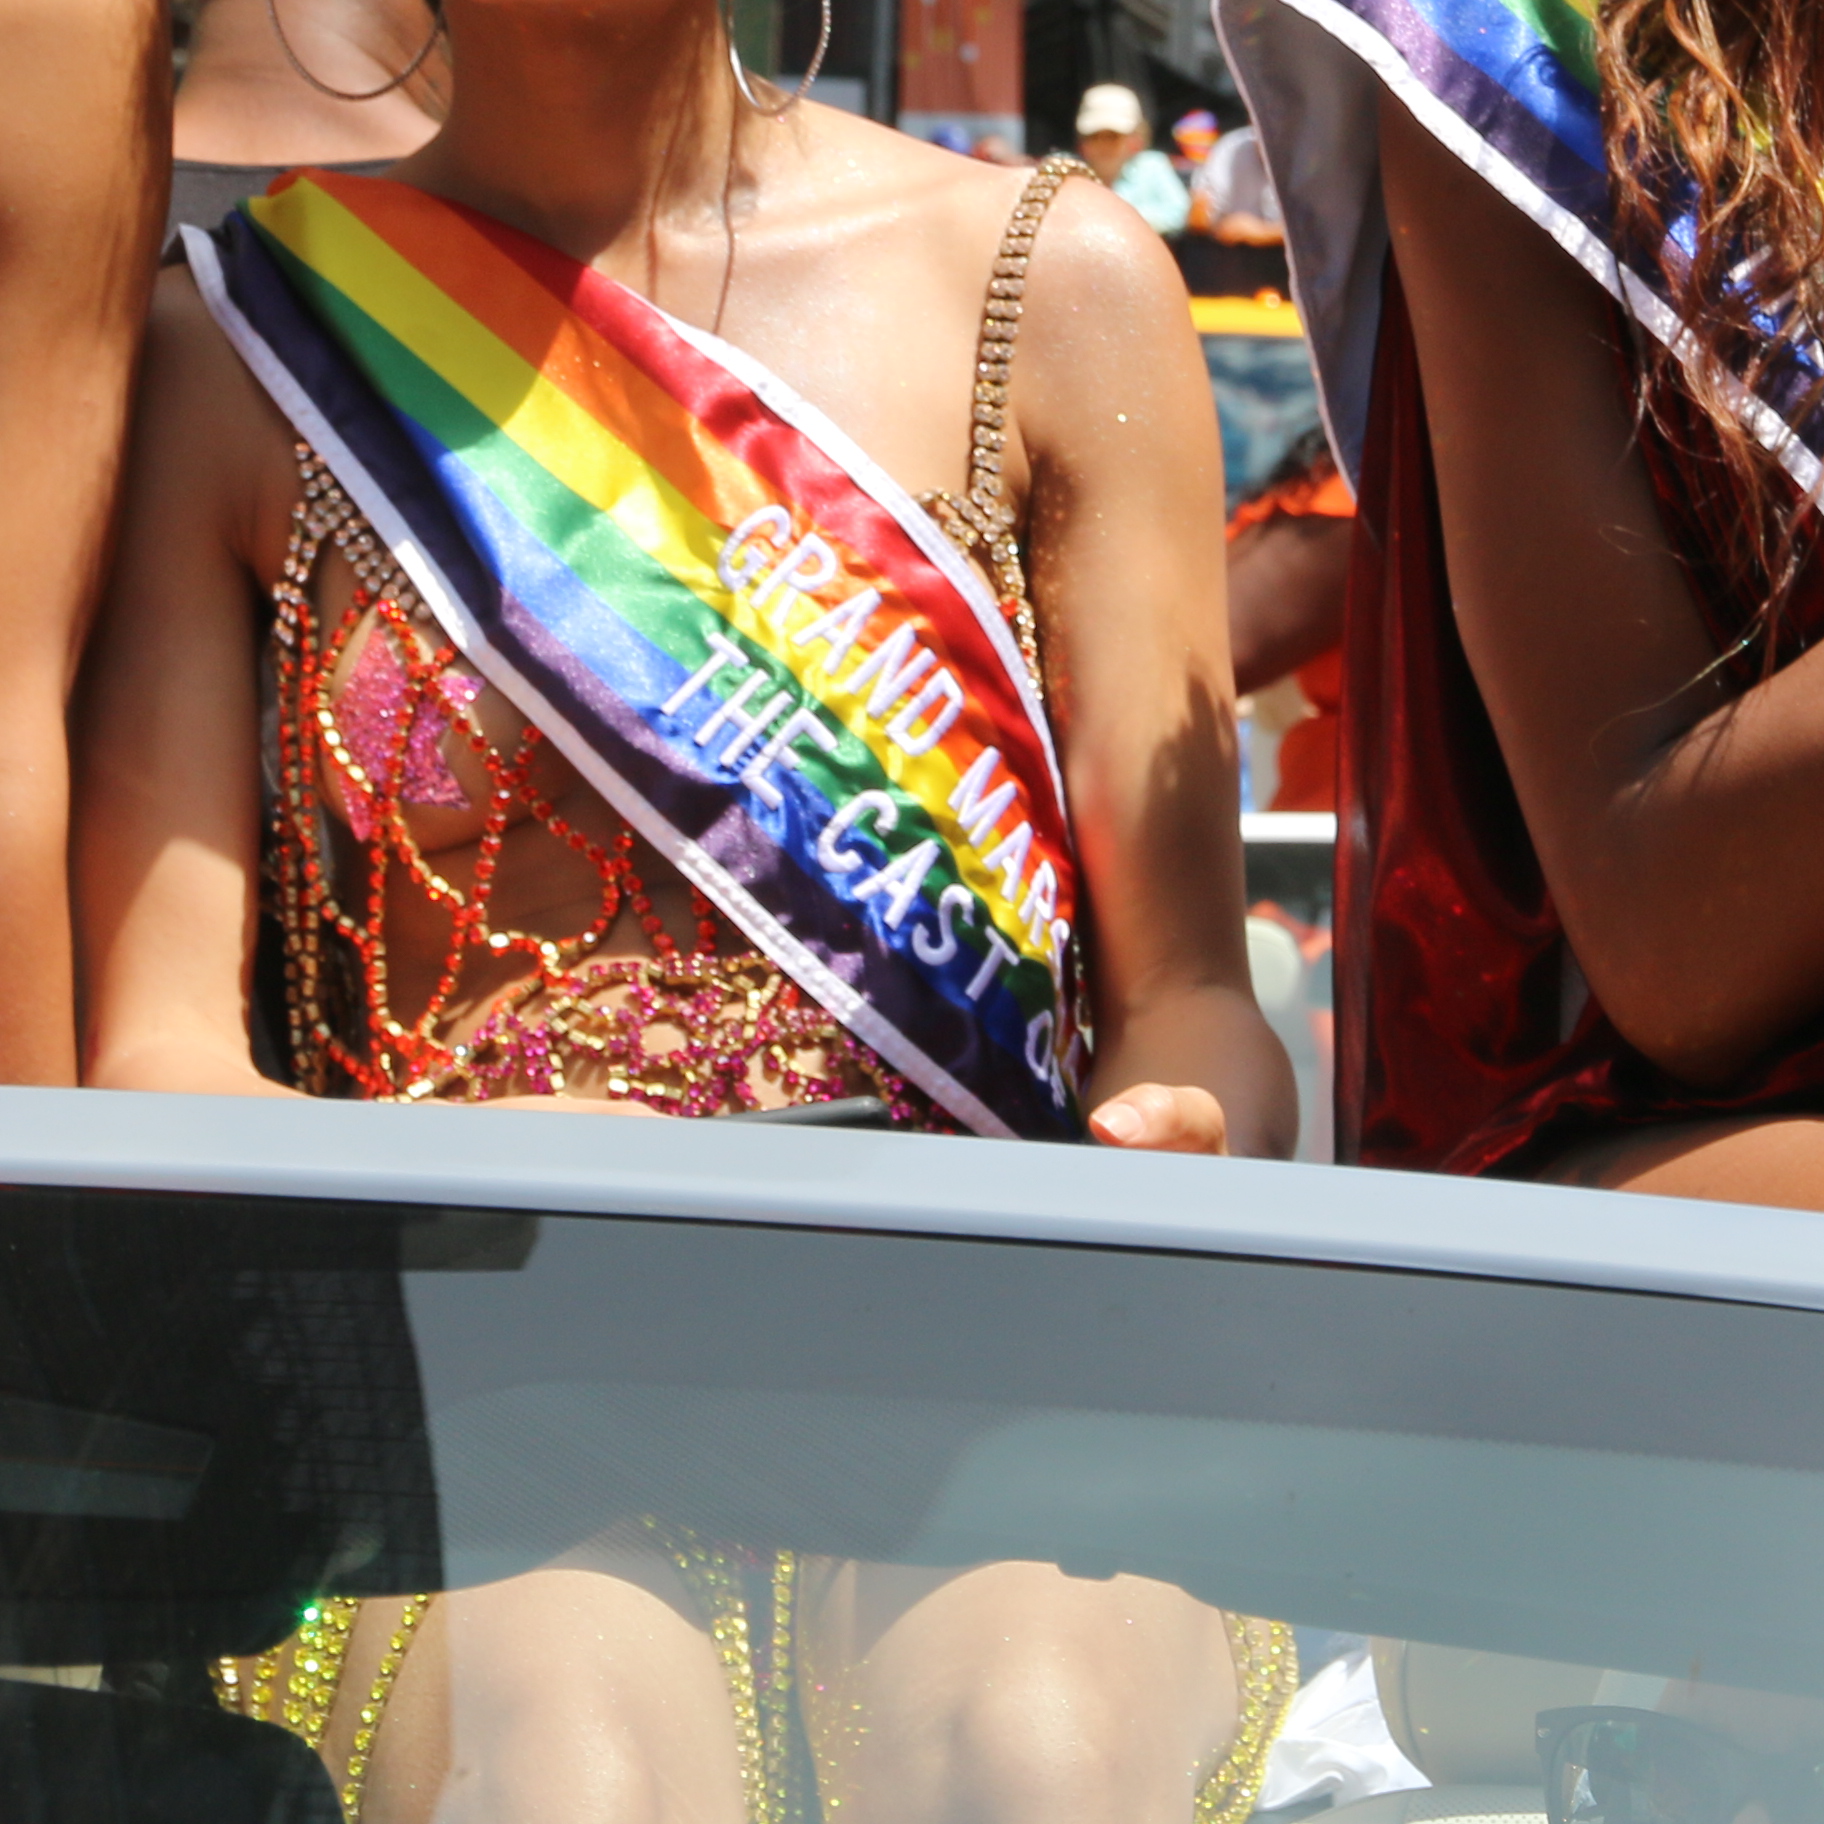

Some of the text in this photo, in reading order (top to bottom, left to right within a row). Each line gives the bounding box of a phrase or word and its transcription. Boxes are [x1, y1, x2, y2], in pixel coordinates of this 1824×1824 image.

[717, 504, 966, 758] GRAND
[660, 631, 838, 811] THE
[818, 789, 1021, 1002] CAST
